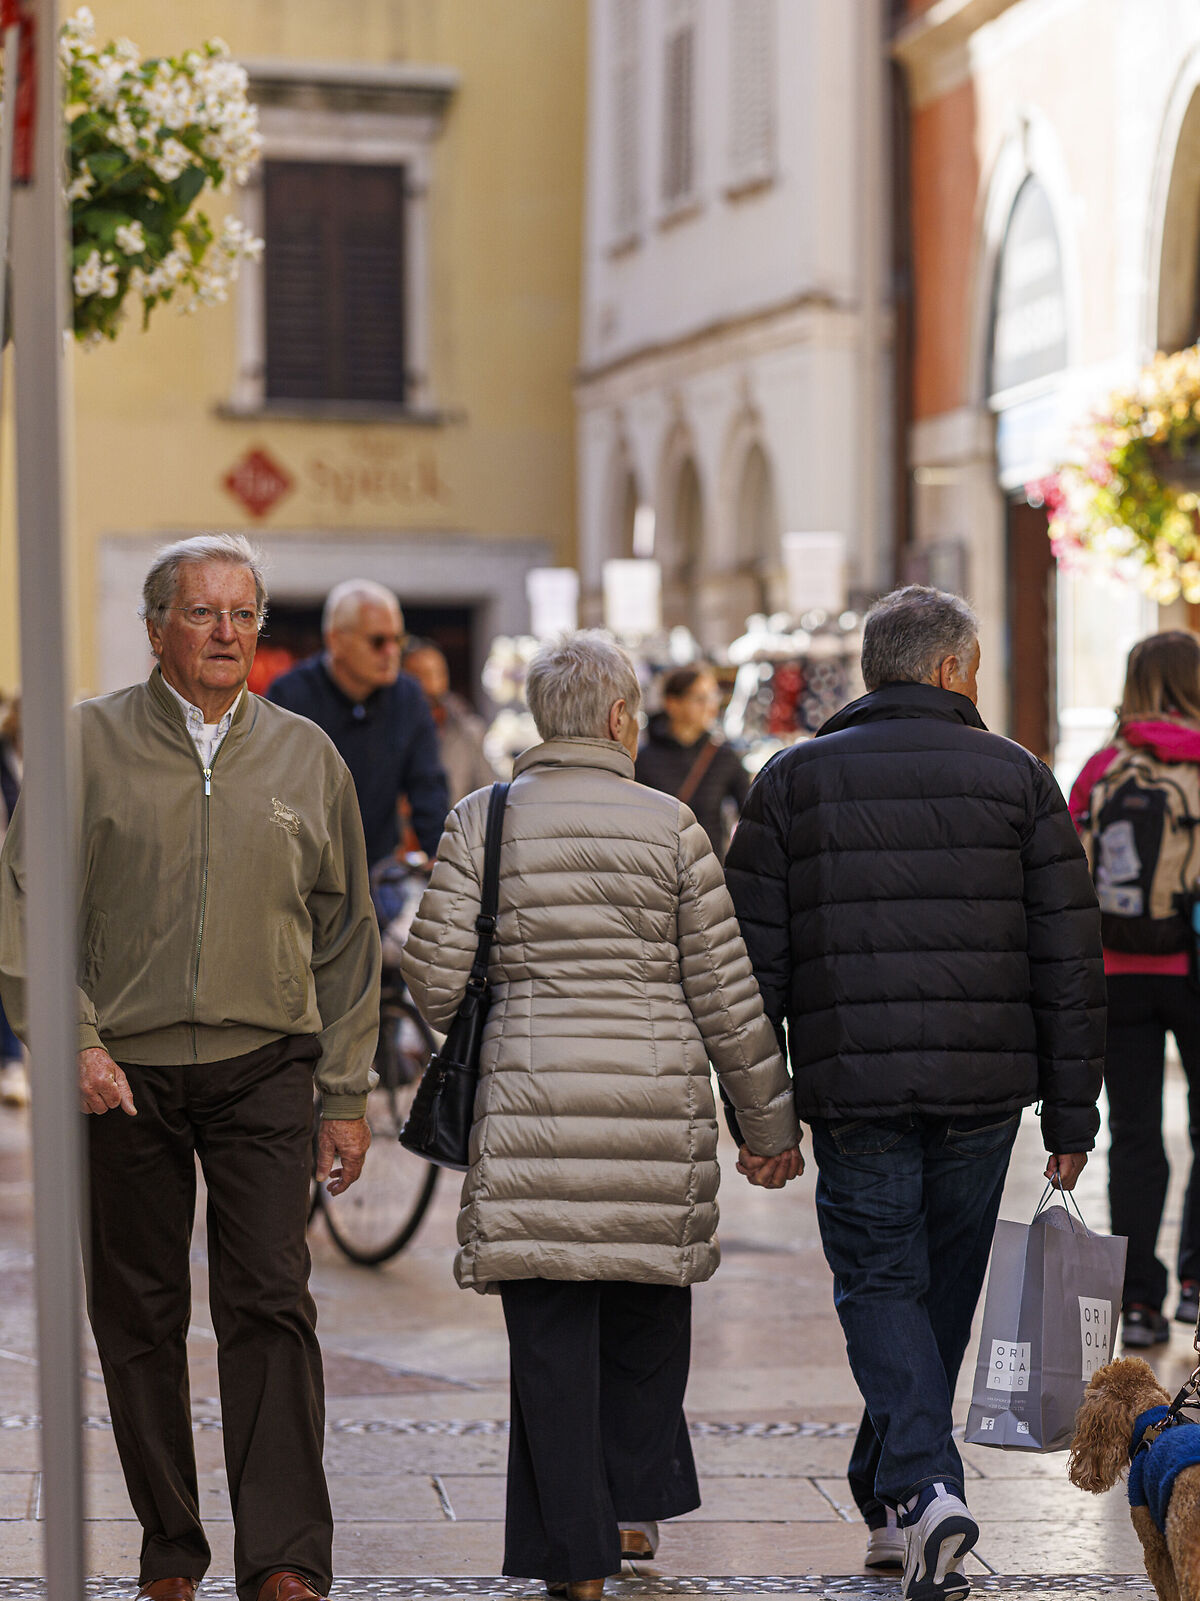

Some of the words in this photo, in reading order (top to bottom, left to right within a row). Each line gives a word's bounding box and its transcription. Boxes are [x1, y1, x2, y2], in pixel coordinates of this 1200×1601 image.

[1084, 1307, 1107, 1325] ORI
[1085, 1331, 1107, 1349] OLA
[996, 1346, 1024, 1358] ORI
[995, 1360, 1026, 1372] OLA
